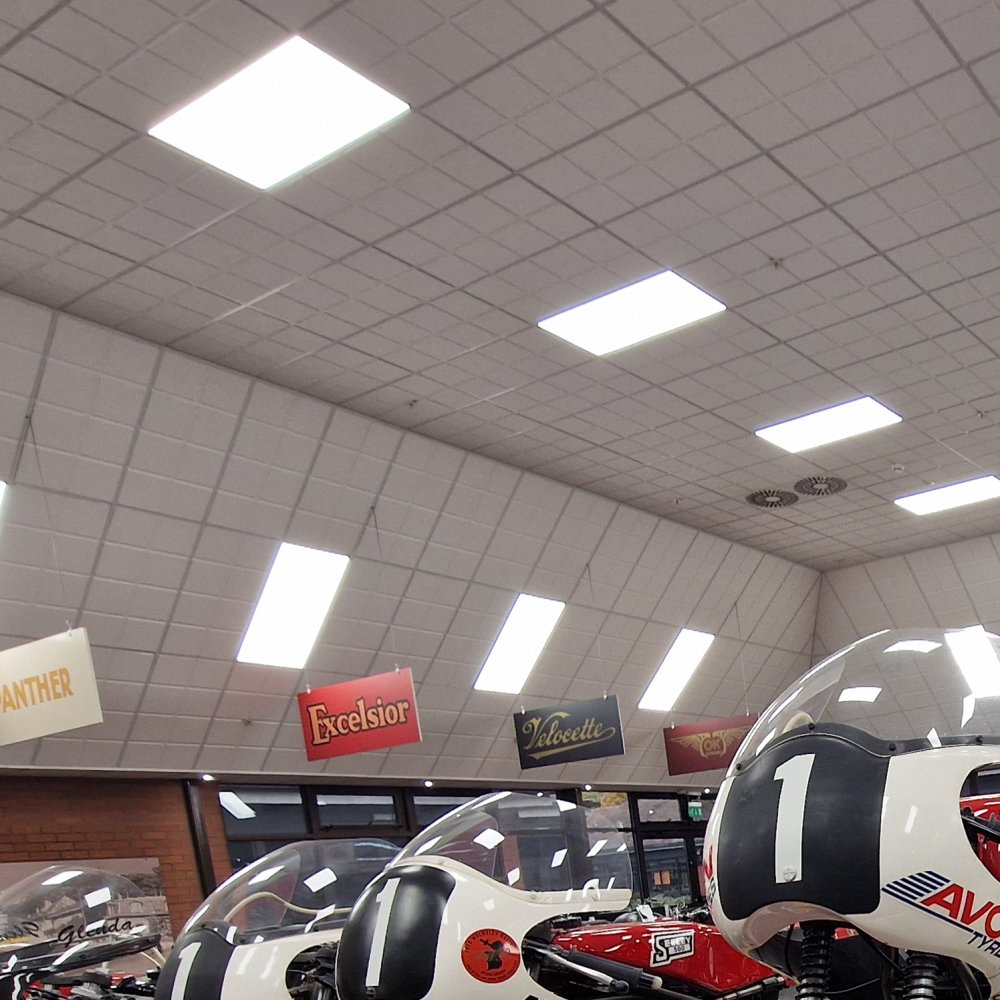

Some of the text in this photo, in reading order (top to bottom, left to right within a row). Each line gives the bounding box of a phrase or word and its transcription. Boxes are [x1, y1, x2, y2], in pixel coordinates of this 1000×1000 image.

[308, 697, 410, 745] Excelsior
[523, 711, 616, 752] Velocette
[774, 754, 814, 884] 1
[366, 878, 401, 987] 1
